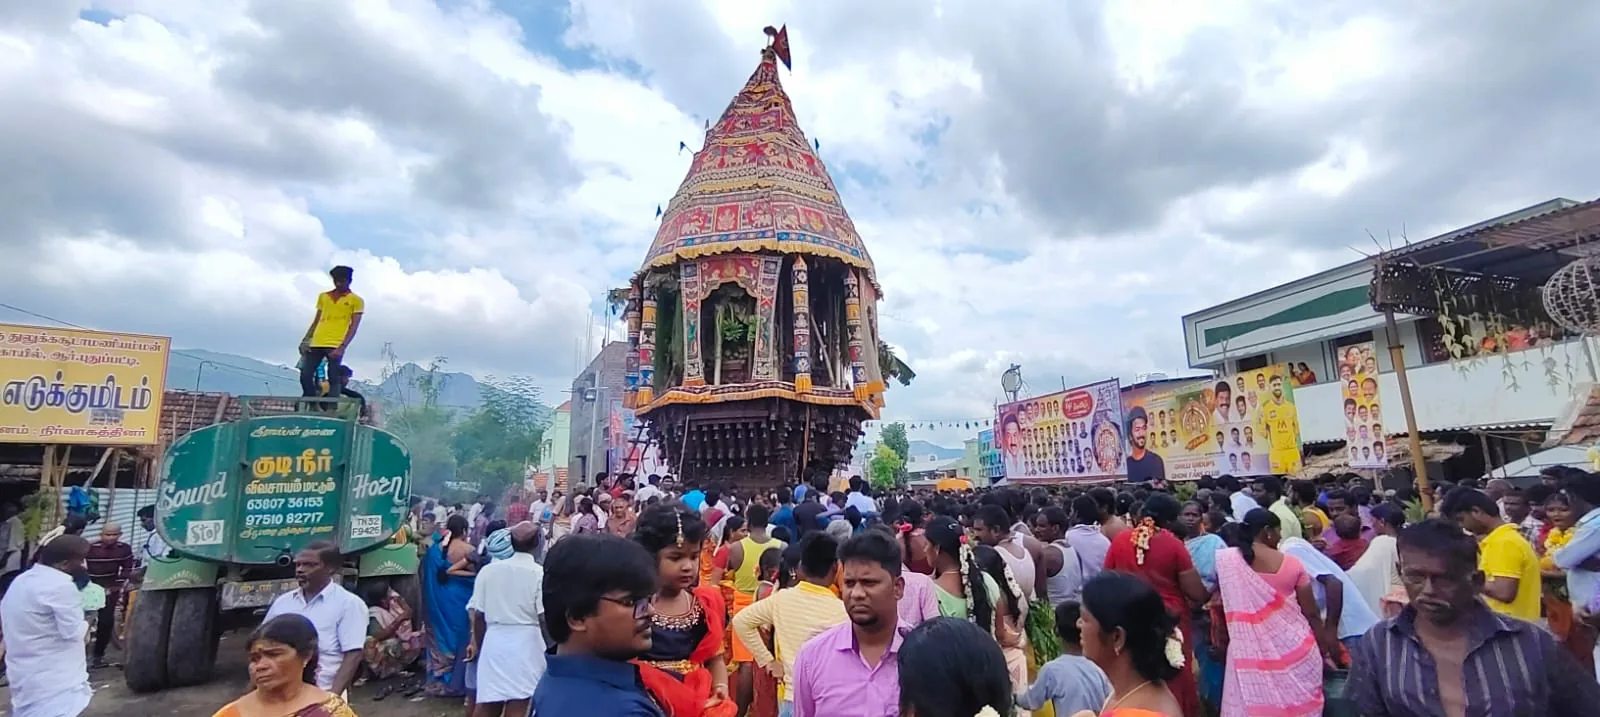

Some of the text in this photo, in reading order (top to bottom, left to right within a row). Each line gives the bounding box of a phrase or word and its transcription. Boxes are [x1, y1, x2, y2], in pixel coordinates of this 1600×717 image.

[3, 371, 152, 413] எடுக்குமிடம்
[157, 472, 227, 511] Sound
[246, 498, 285, 510] 63807
[245, 512, 324, 526] 97510 82717
